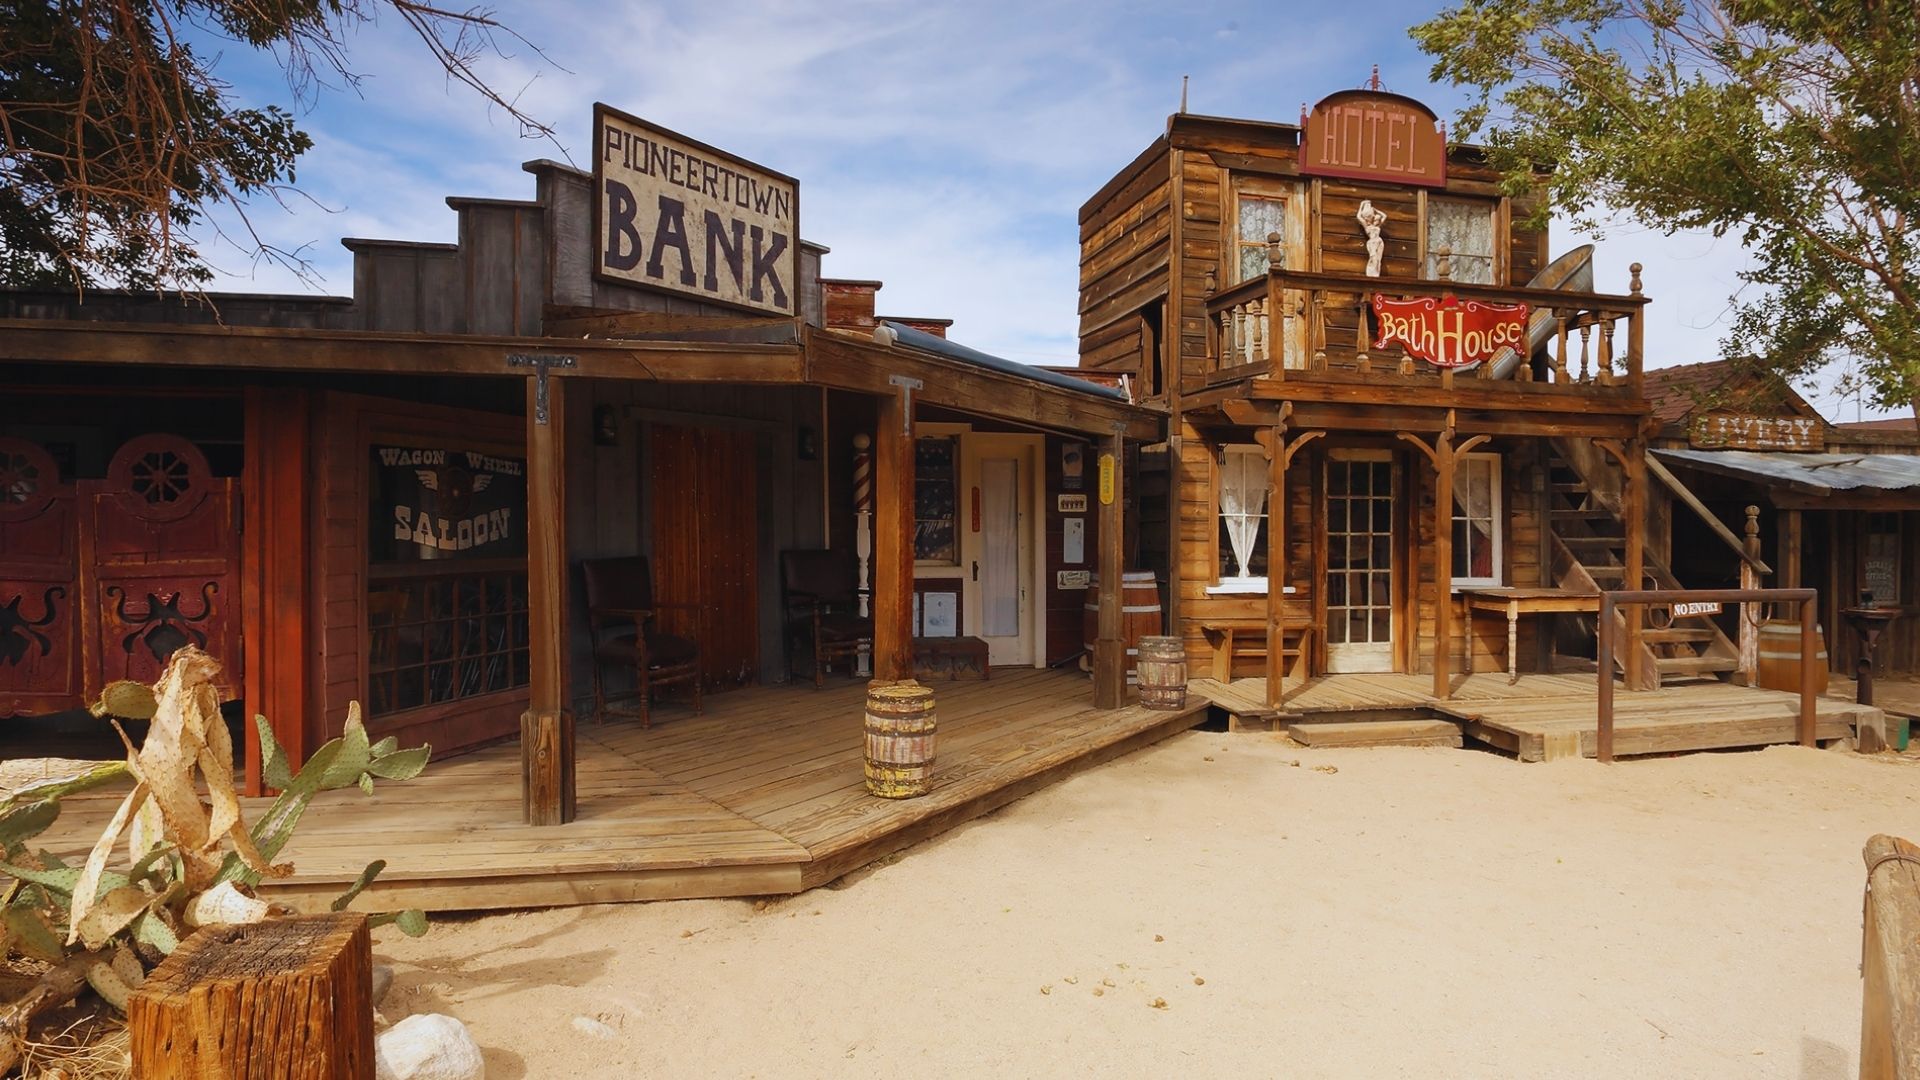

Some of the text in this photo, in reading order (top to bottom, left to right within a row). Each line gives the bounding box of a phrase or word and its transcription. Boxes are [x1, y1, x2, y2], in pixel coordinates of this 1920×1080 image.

[1320, 106, 1425, 174] HOTEL
[604, 124, 790, 221] PIONEERTOWN
[604, 178, 788, 310] BANK
[379, 448, 521, 476] WAGON WHEEL
[394, 505, 511, 551] SALOON
[1674, 602, 1719, 616] NO ENTRY
